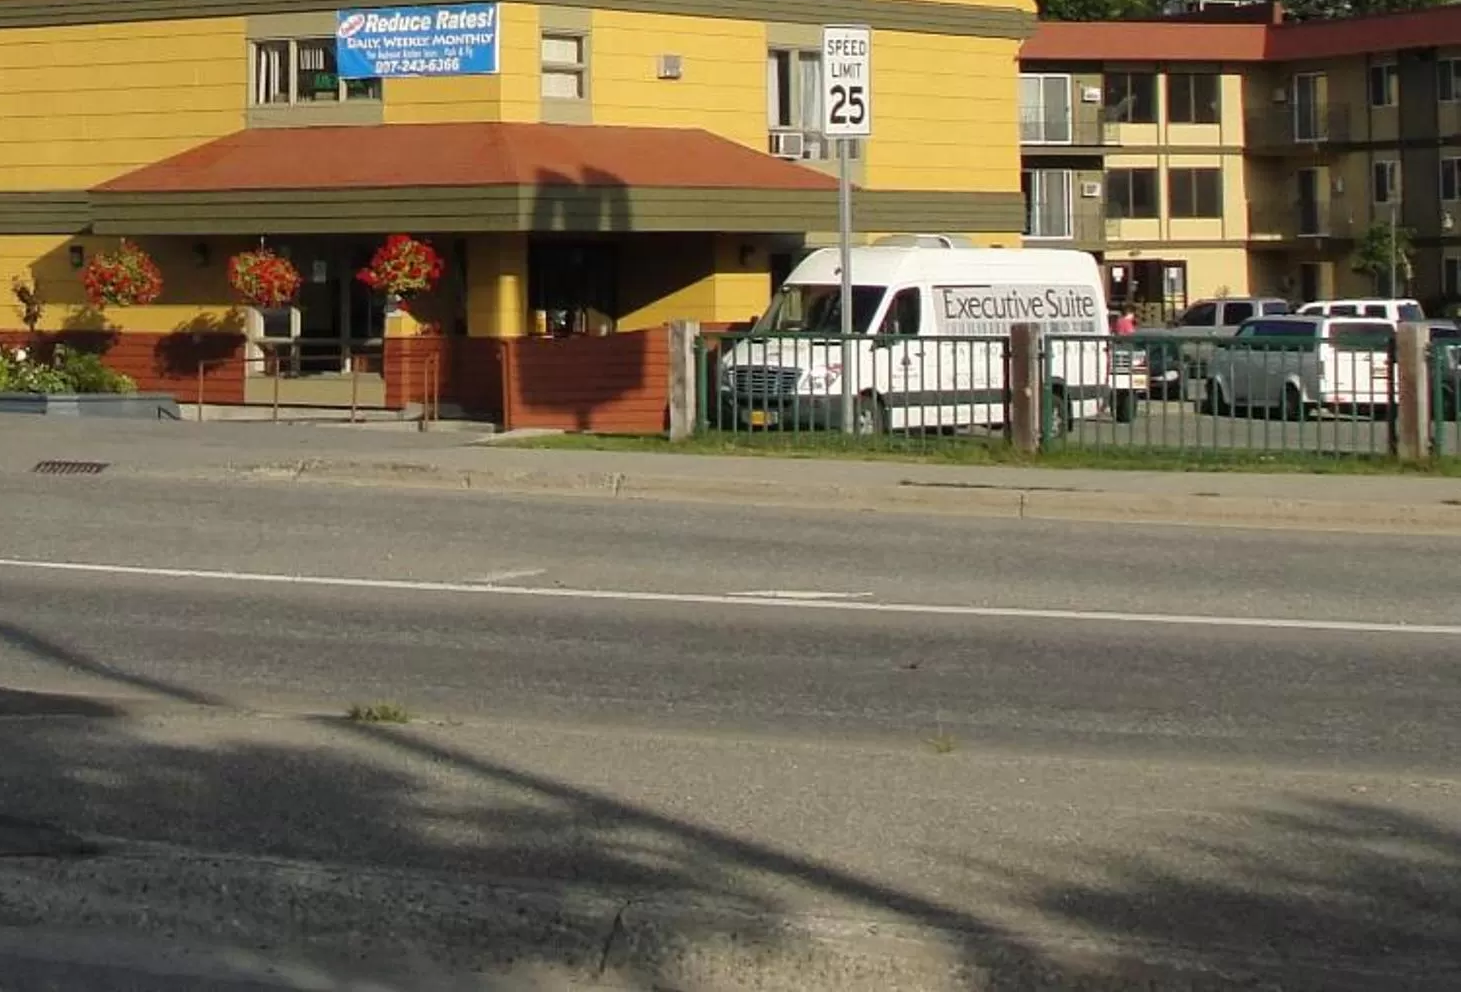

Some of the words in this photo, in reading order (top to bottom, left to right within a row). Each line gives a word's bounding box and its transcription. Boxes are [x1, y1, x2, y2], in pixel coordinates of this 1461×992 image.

[365, 12, 432, 33] Reduce
[436, 8, 494, 30] Rates!
[432, 32, 494, 46] MONTHLY
[827, 39, 866, 56] SPEED
[832, 63, 862, 78] LIMIT
[830, 85, 865, 124] 25
[942, 289, 1044, 319] Executive
[1045, 288, 1095, 319] Suite
